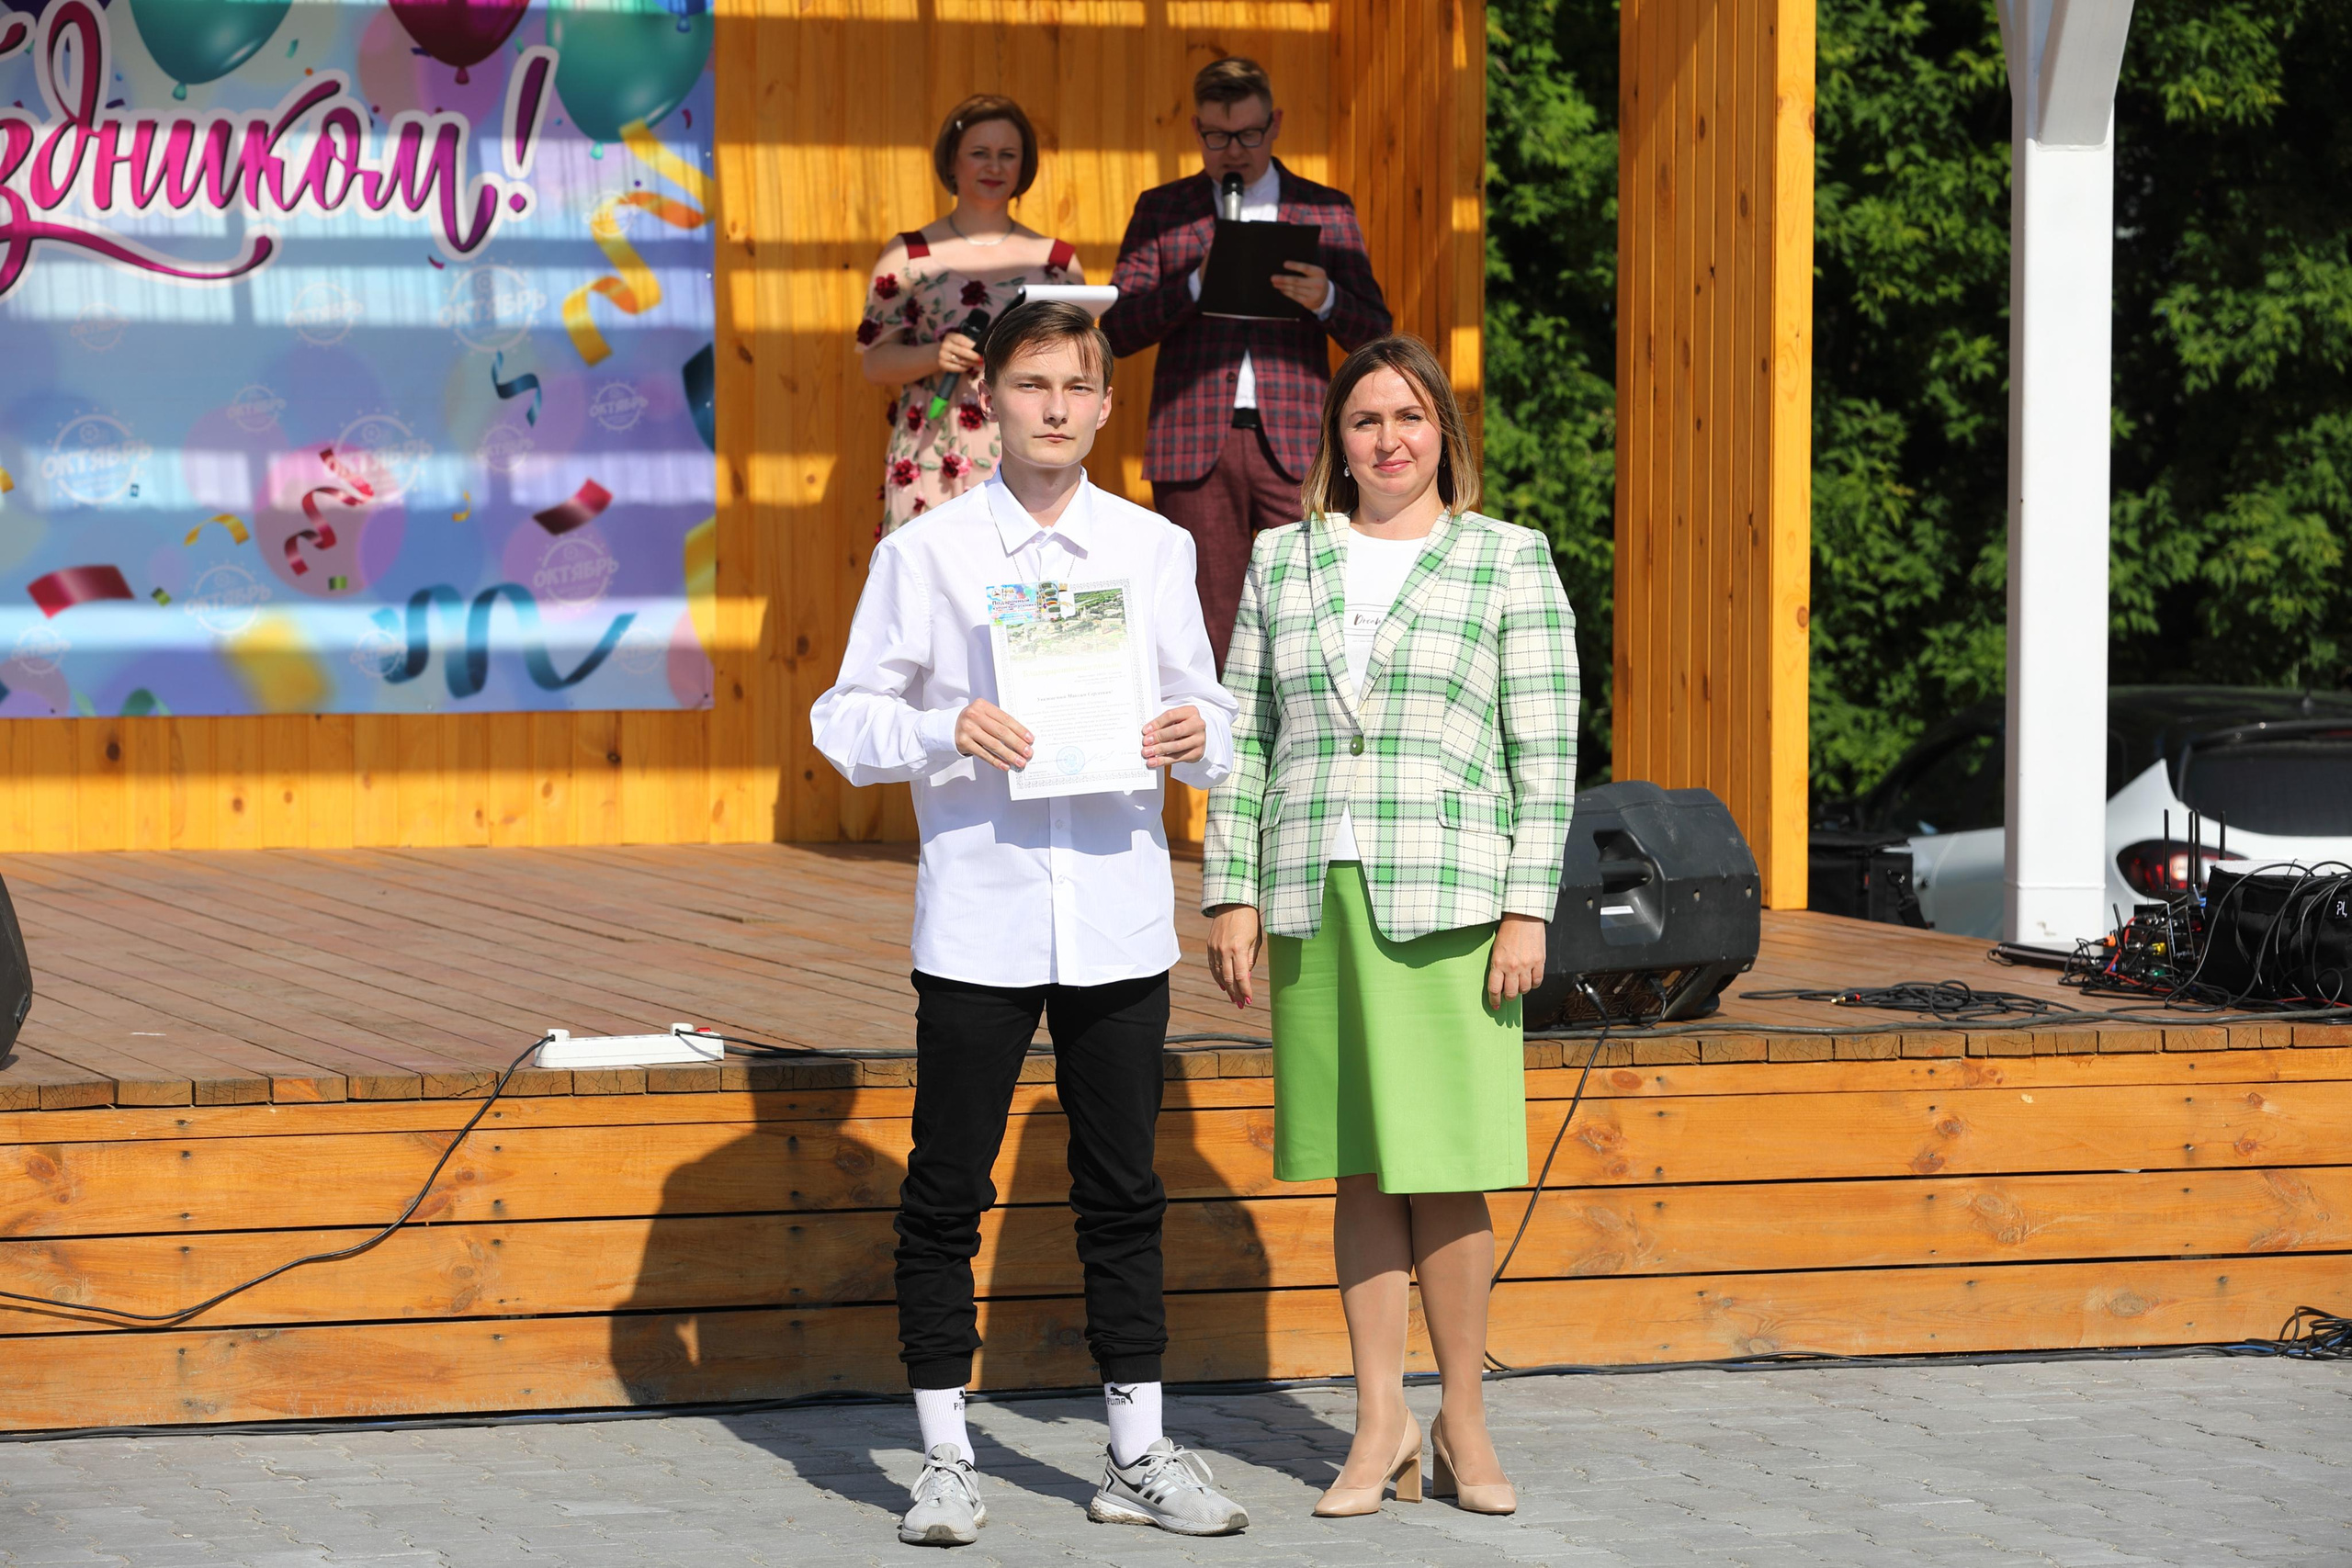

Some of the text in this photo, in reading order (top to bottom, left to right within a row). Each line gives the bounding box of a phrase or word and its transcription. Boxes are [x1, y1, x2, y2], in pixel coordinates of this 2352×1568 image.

[40, 439, 153, 479] ОКТЯБРЬ
[533, 556, 619, 588] ОКТЯБРЬ
[1106, 1396, 1126, 1406] PUMA
